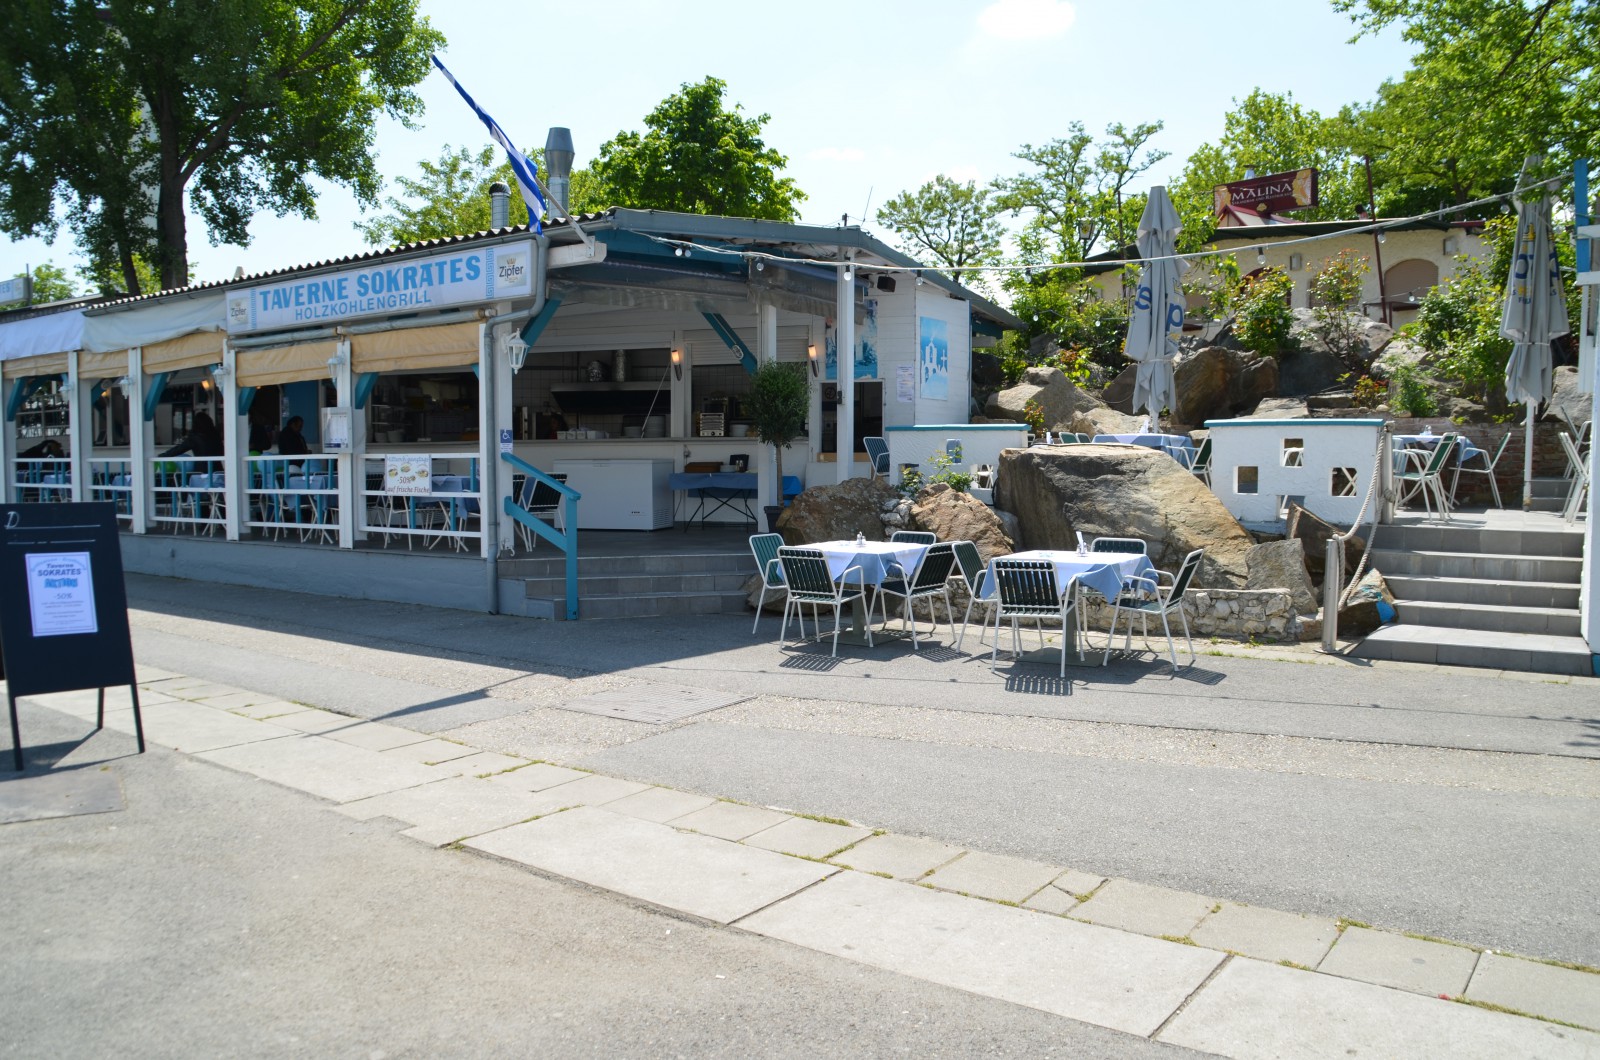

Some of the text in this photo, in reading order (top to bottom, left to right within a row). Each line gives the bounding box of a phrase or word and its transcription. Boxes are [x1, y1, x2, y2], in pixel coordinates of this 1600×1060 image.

[1232, 183, 1292, 201] MALINA
[499, 265, 524, 278] Zipfer
[260, 255, 481, 312] TAVERNE SOKRATES
[295, 290, 432, 321] HOLZKOHLENGRILL
[37, 568, 82, 577] SOKRATES
